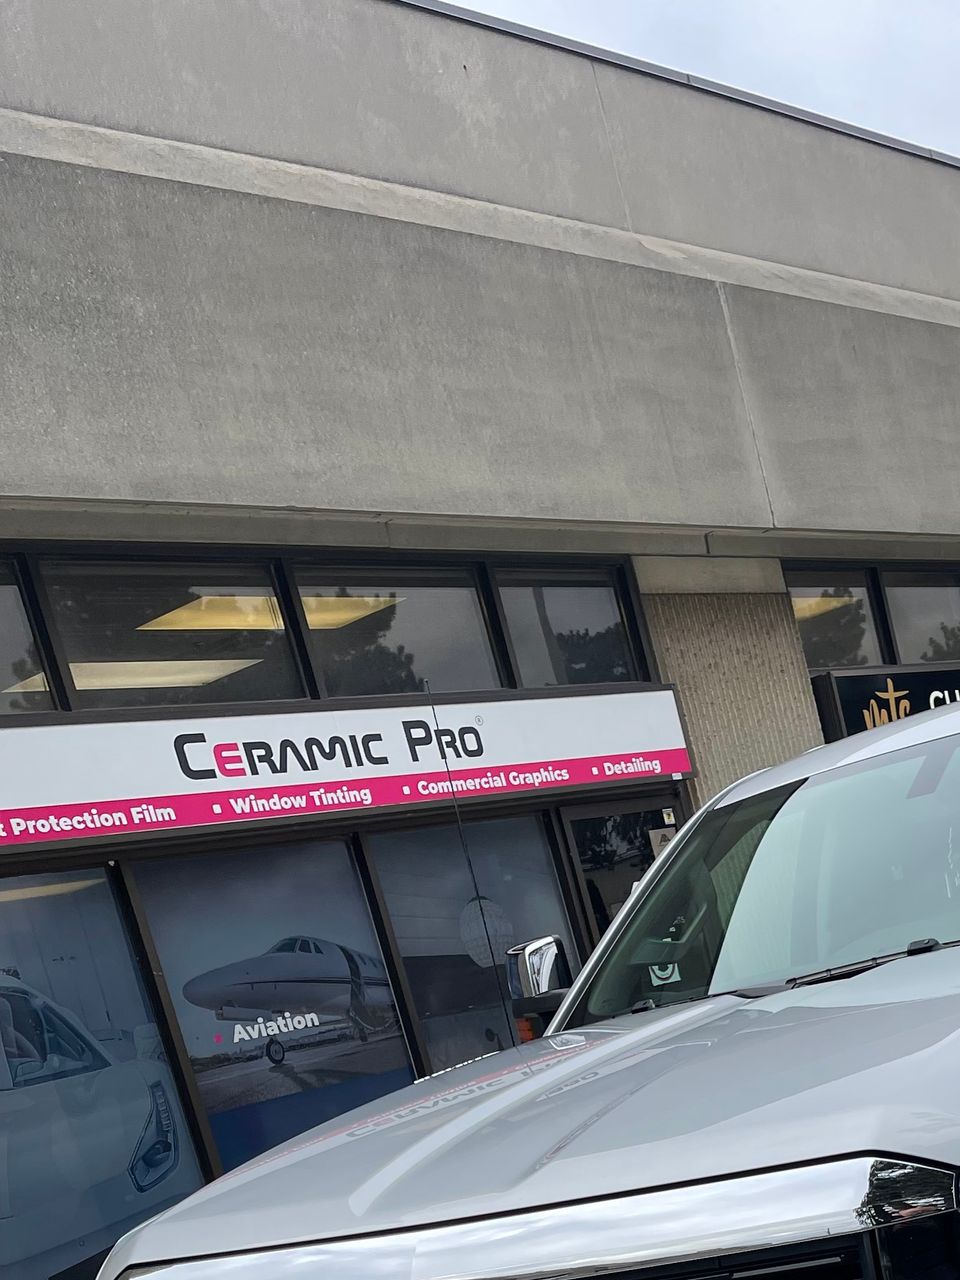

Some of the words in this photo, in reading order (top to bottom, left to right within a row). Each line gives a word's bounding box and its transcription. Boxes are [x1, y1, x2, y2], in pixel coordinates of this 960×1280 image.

[173, 731, 389, 780] CERAMIC
[603, 757, 662, 776] Detailing
[417, 774, 507, 796] Commercial
[508, 766, 570, 787] Graphics
[229, 794, 307, 814] Window
[309, 786, 372, 805] Tinting
[9, 808, 128, 836] Protection
[130, 803, 177, 824] Film
[233, 1011, 320, 1043] Aviation
